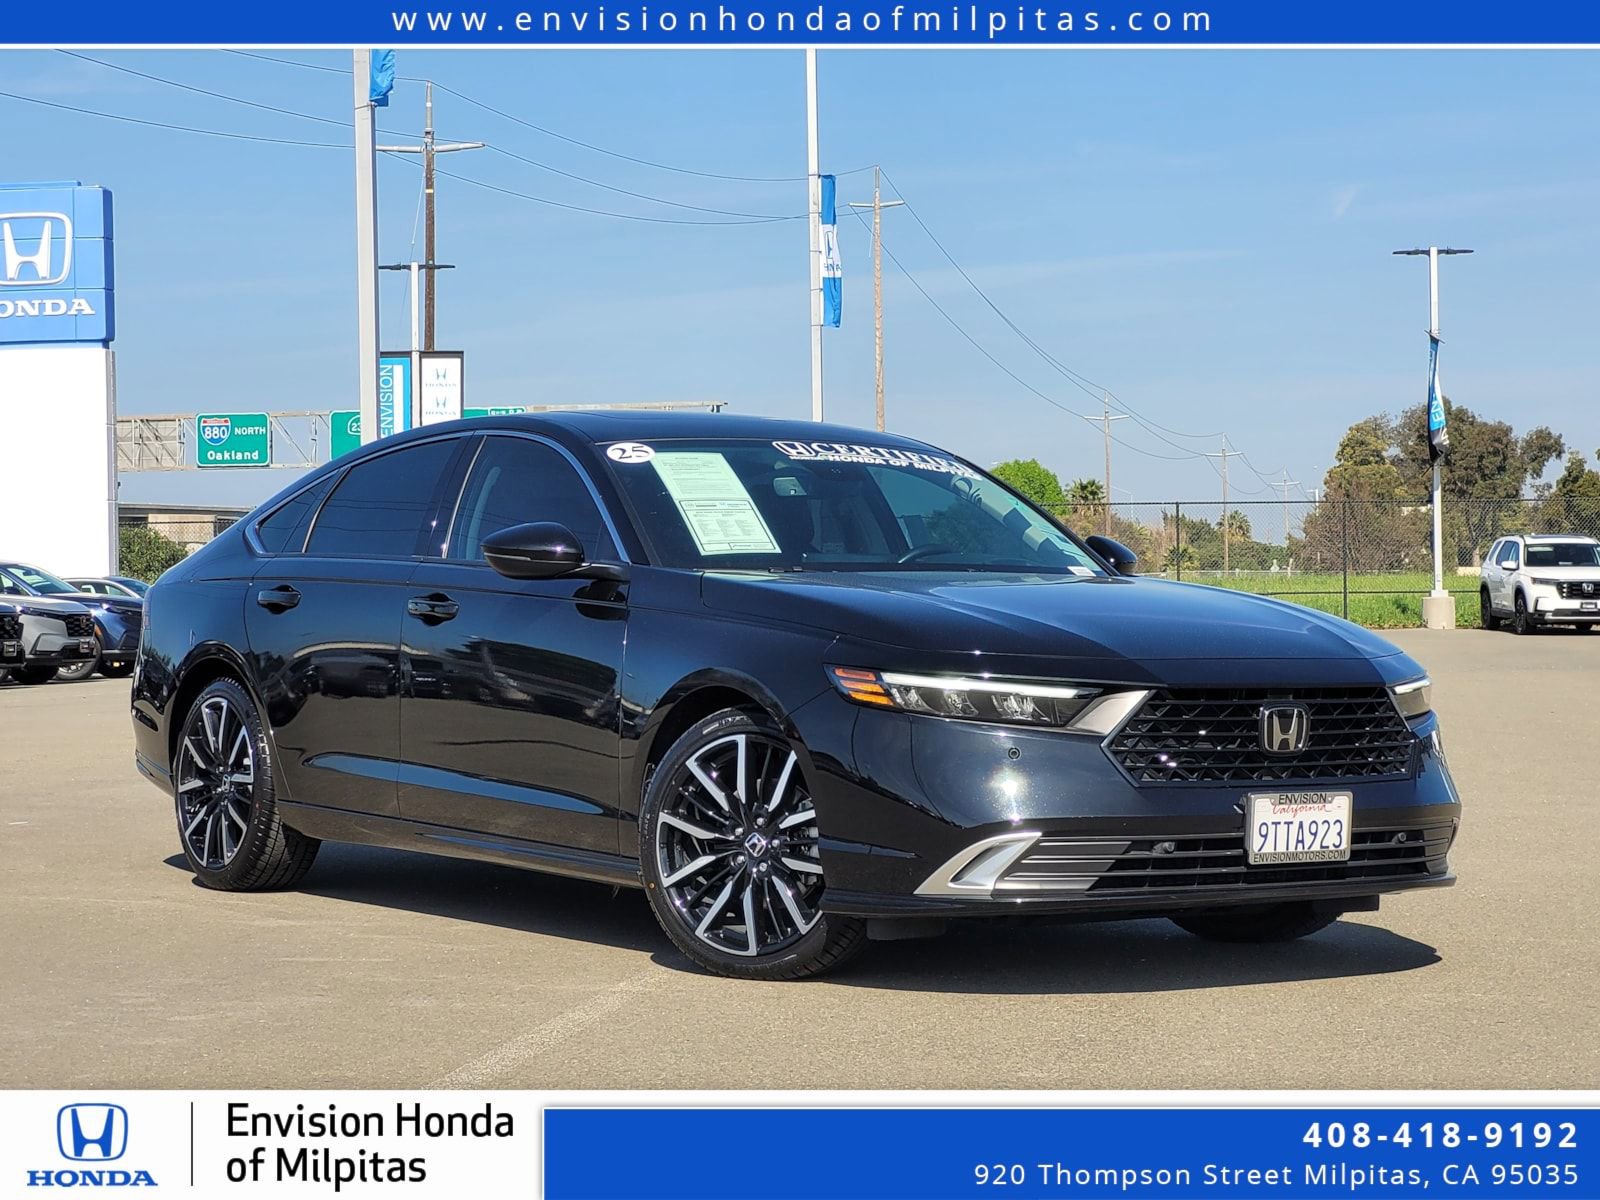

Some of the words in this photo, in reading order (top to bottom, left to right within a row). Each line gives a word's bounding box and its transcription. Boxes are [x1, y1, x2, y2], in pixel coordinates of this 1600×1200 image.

[379, 364, 394, 438] ENVISION
[204, 426, 228, 439] 880
[234, 426, 267, 436] NORTH
[207, 450, 260, 461] Oakland
[611, 445, 650, 460] 25
[1278, 793, 1327, 806] ENVISION
[1272, 803, 1333, 819] California
[1257, 819, 1343, 852] 9TTA923
[1253, 850, 1346, 863] ENVISIONMOTORS.COM
